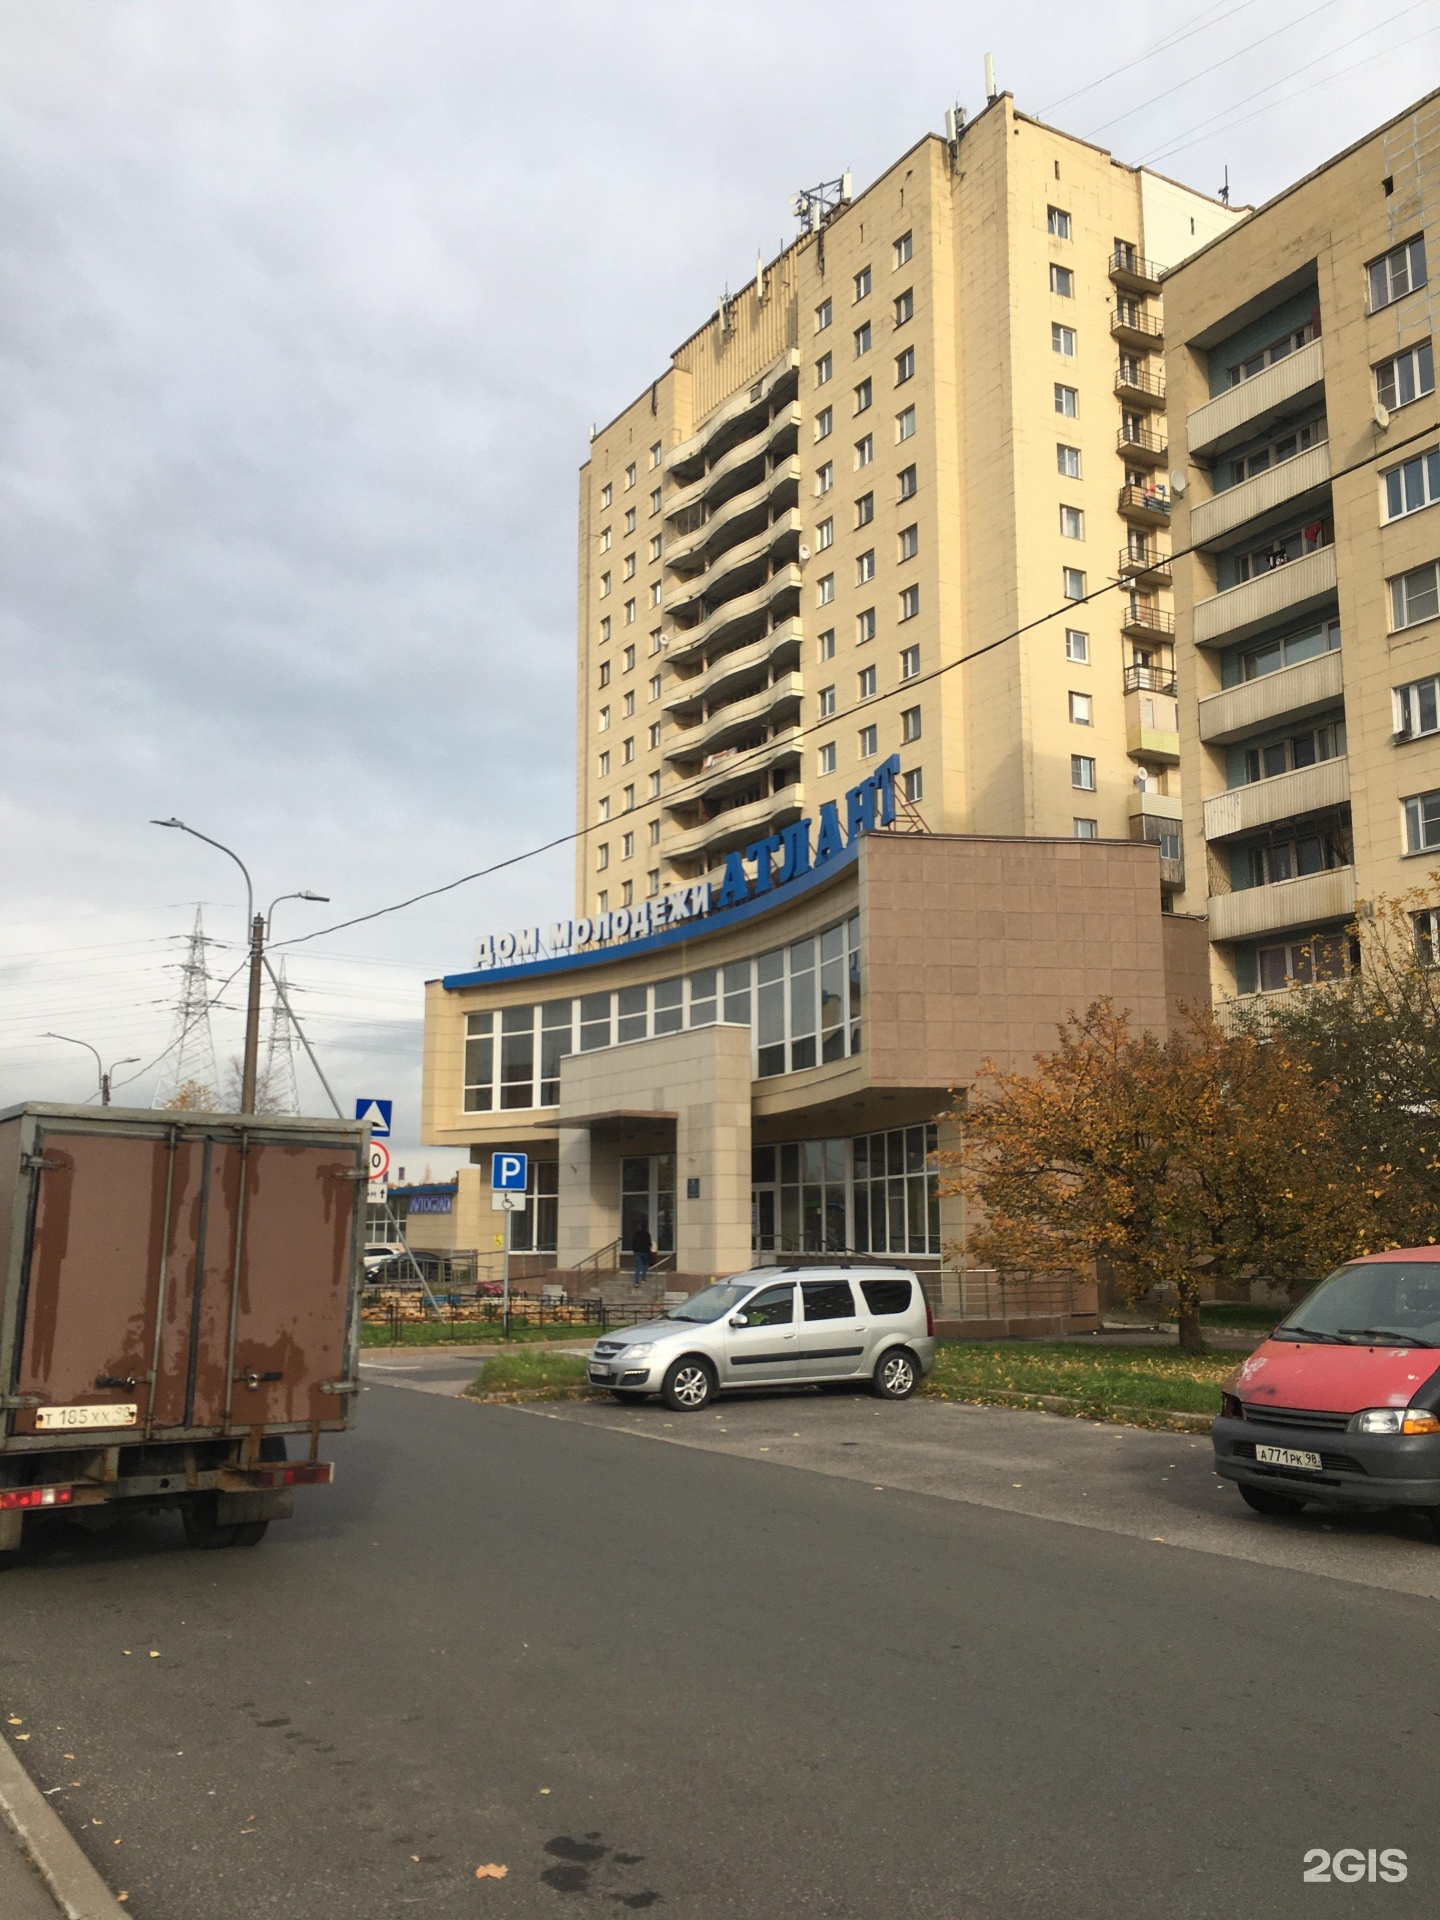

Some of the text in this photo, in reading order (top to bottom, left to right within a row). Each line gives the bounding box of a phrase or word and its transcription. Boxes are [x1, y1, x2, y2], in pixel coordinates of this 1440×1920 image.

[474, 753, 901, 968] ДОМ МОЛОДЕЖИ АТЛАНТ
[502, 1157, 521, 1186] P
